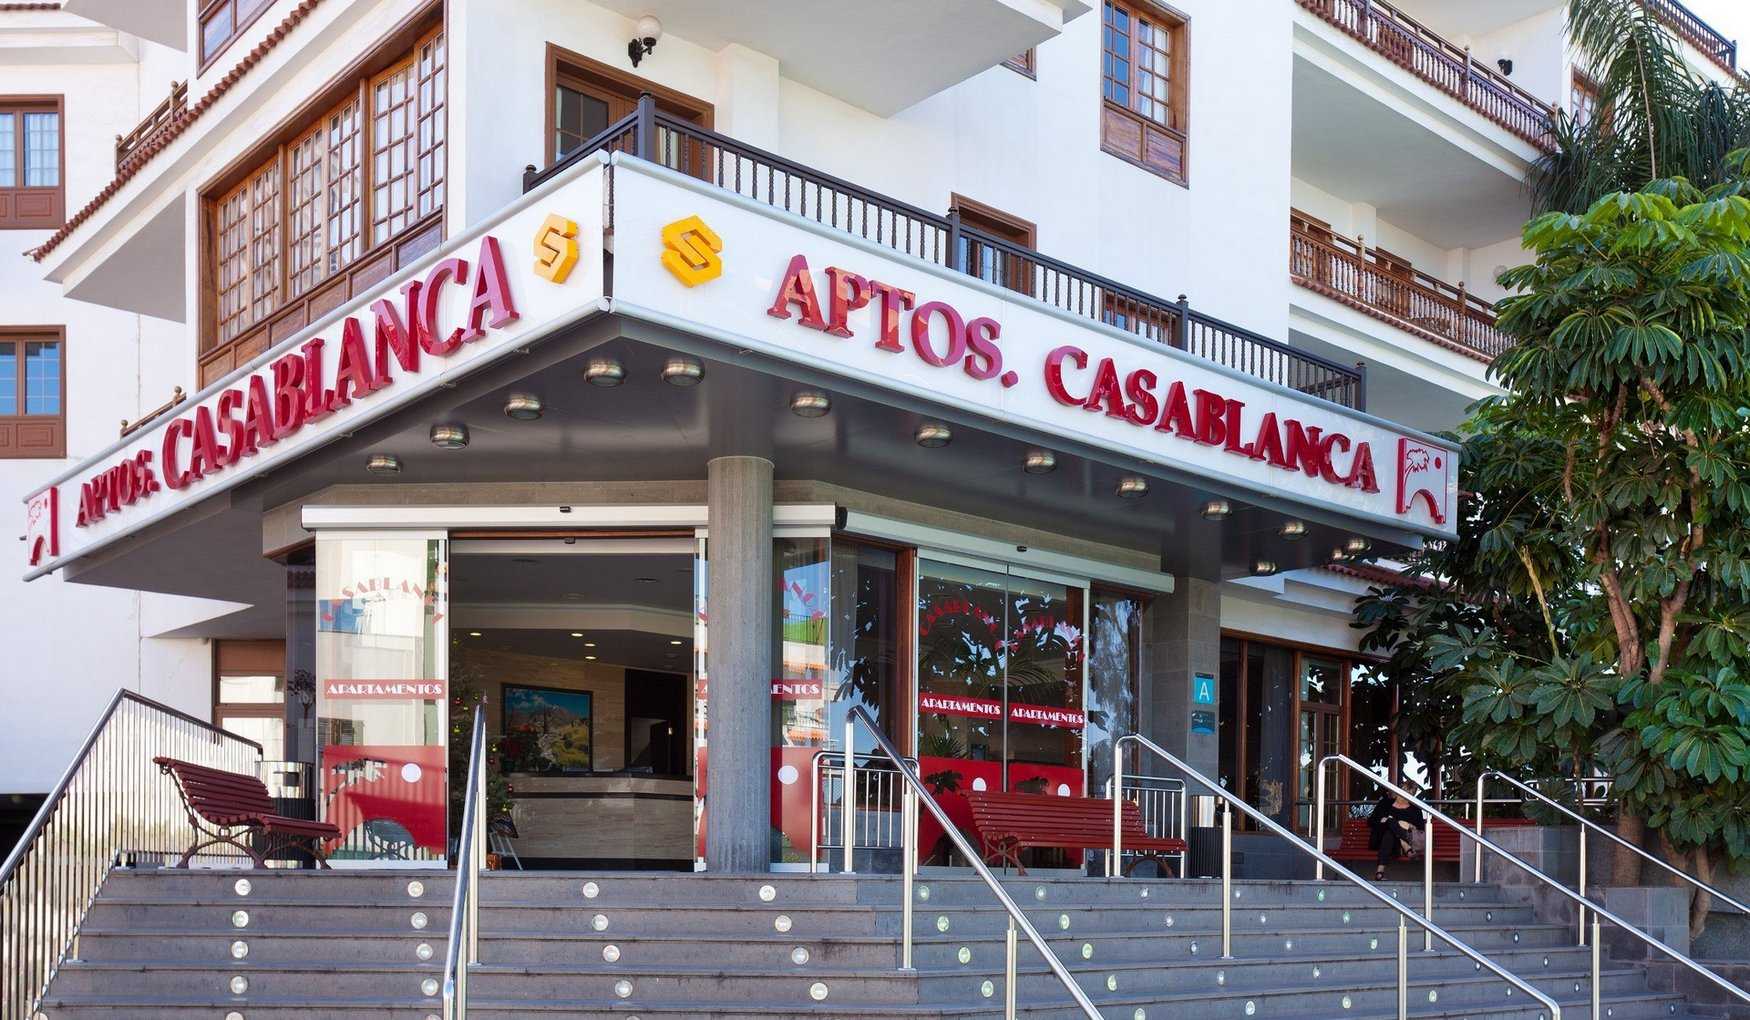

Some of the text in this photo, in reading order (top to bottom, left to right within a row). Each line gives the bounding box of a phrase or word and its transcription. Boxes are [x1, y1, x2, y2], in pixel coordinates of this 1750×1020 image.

[76, 235, 520, 528] APTOS. CASABLANCA
[767, 254, 1380, 494] APTOS. CASABLANCA
[327, 683, 442, 695] APARTAMENTOS
[1199, 681, 1210, 701] A
[921, 697, 1001, 715] APARTAMENTOS
[1011, 707, 1084, 724] APARTAMENTOS
